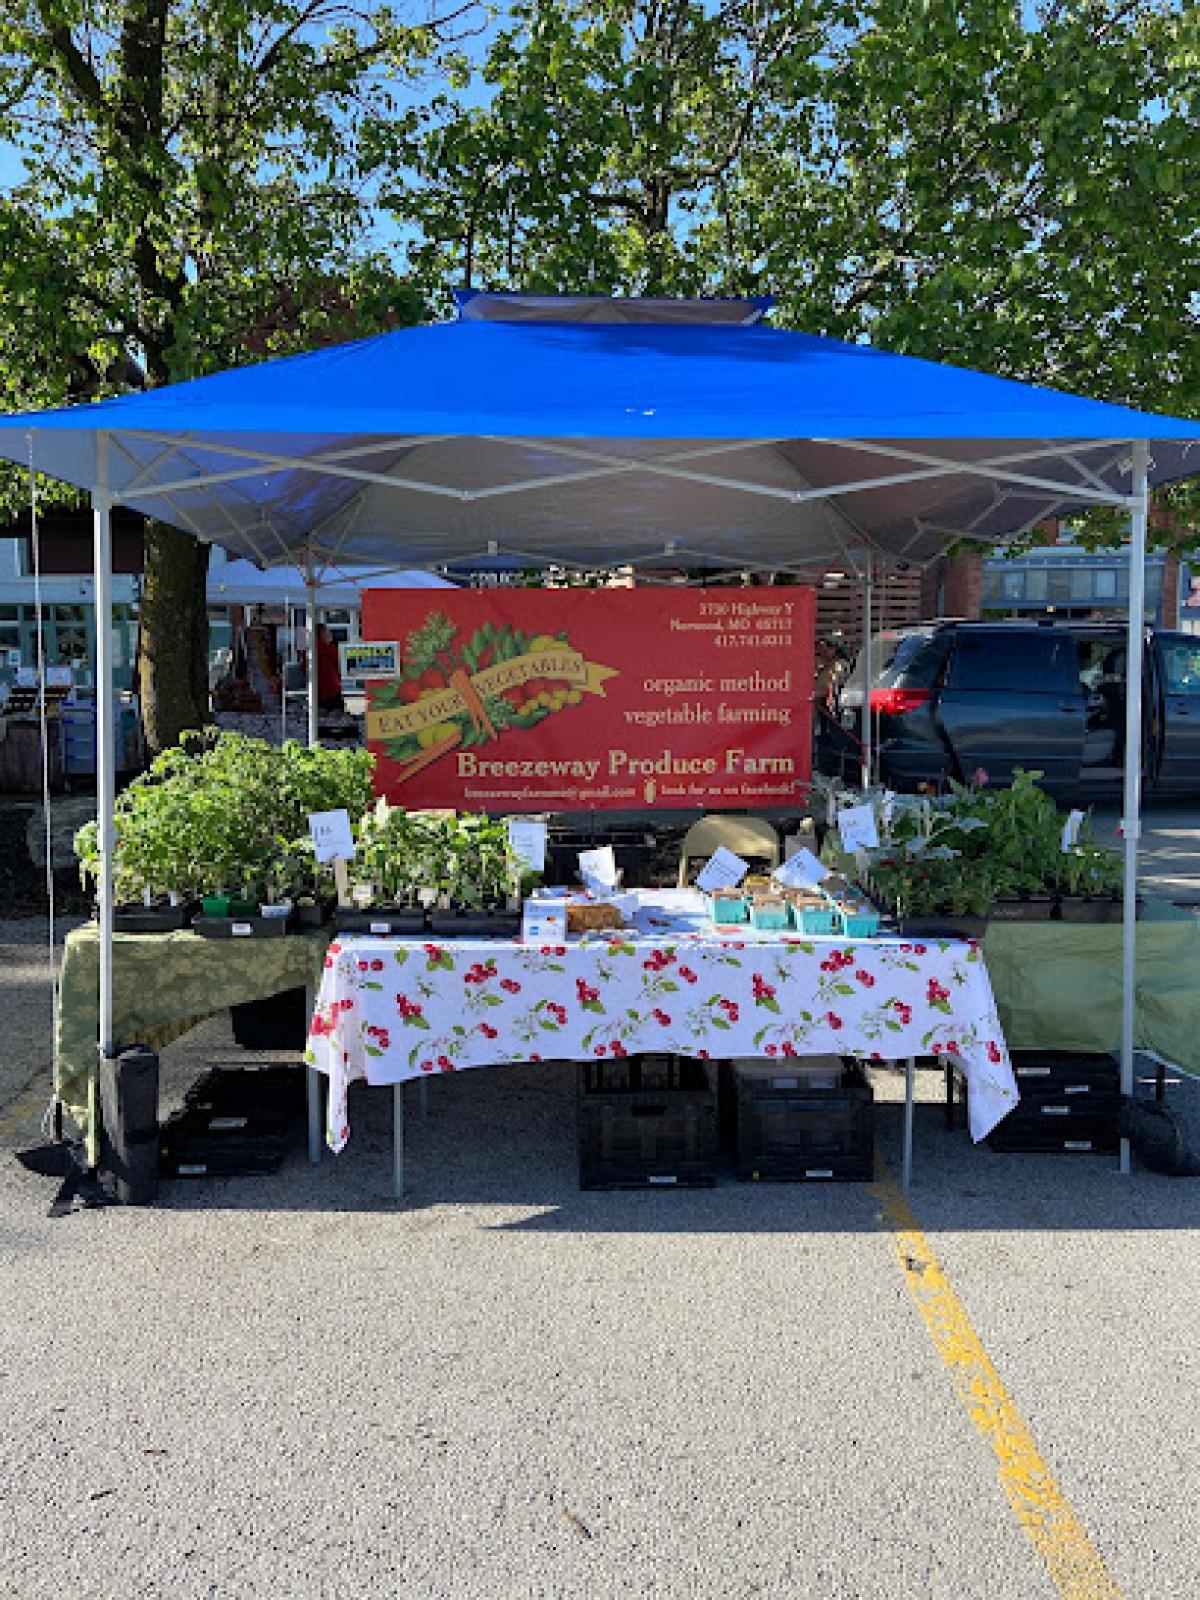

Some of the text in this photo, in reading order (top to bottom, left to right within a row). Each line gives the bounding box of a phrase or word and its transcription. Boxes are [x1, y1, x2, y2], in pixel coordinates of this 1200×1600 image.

[417, 692, 465, 721] YOUR
[476, 660, 581, 694] VEGETABLES
[644, 670, 791, 697] organic method
[624, 703, 791, 727] vegetable farming
[456, 749, 795, 780] Breezeway Produce Farm
